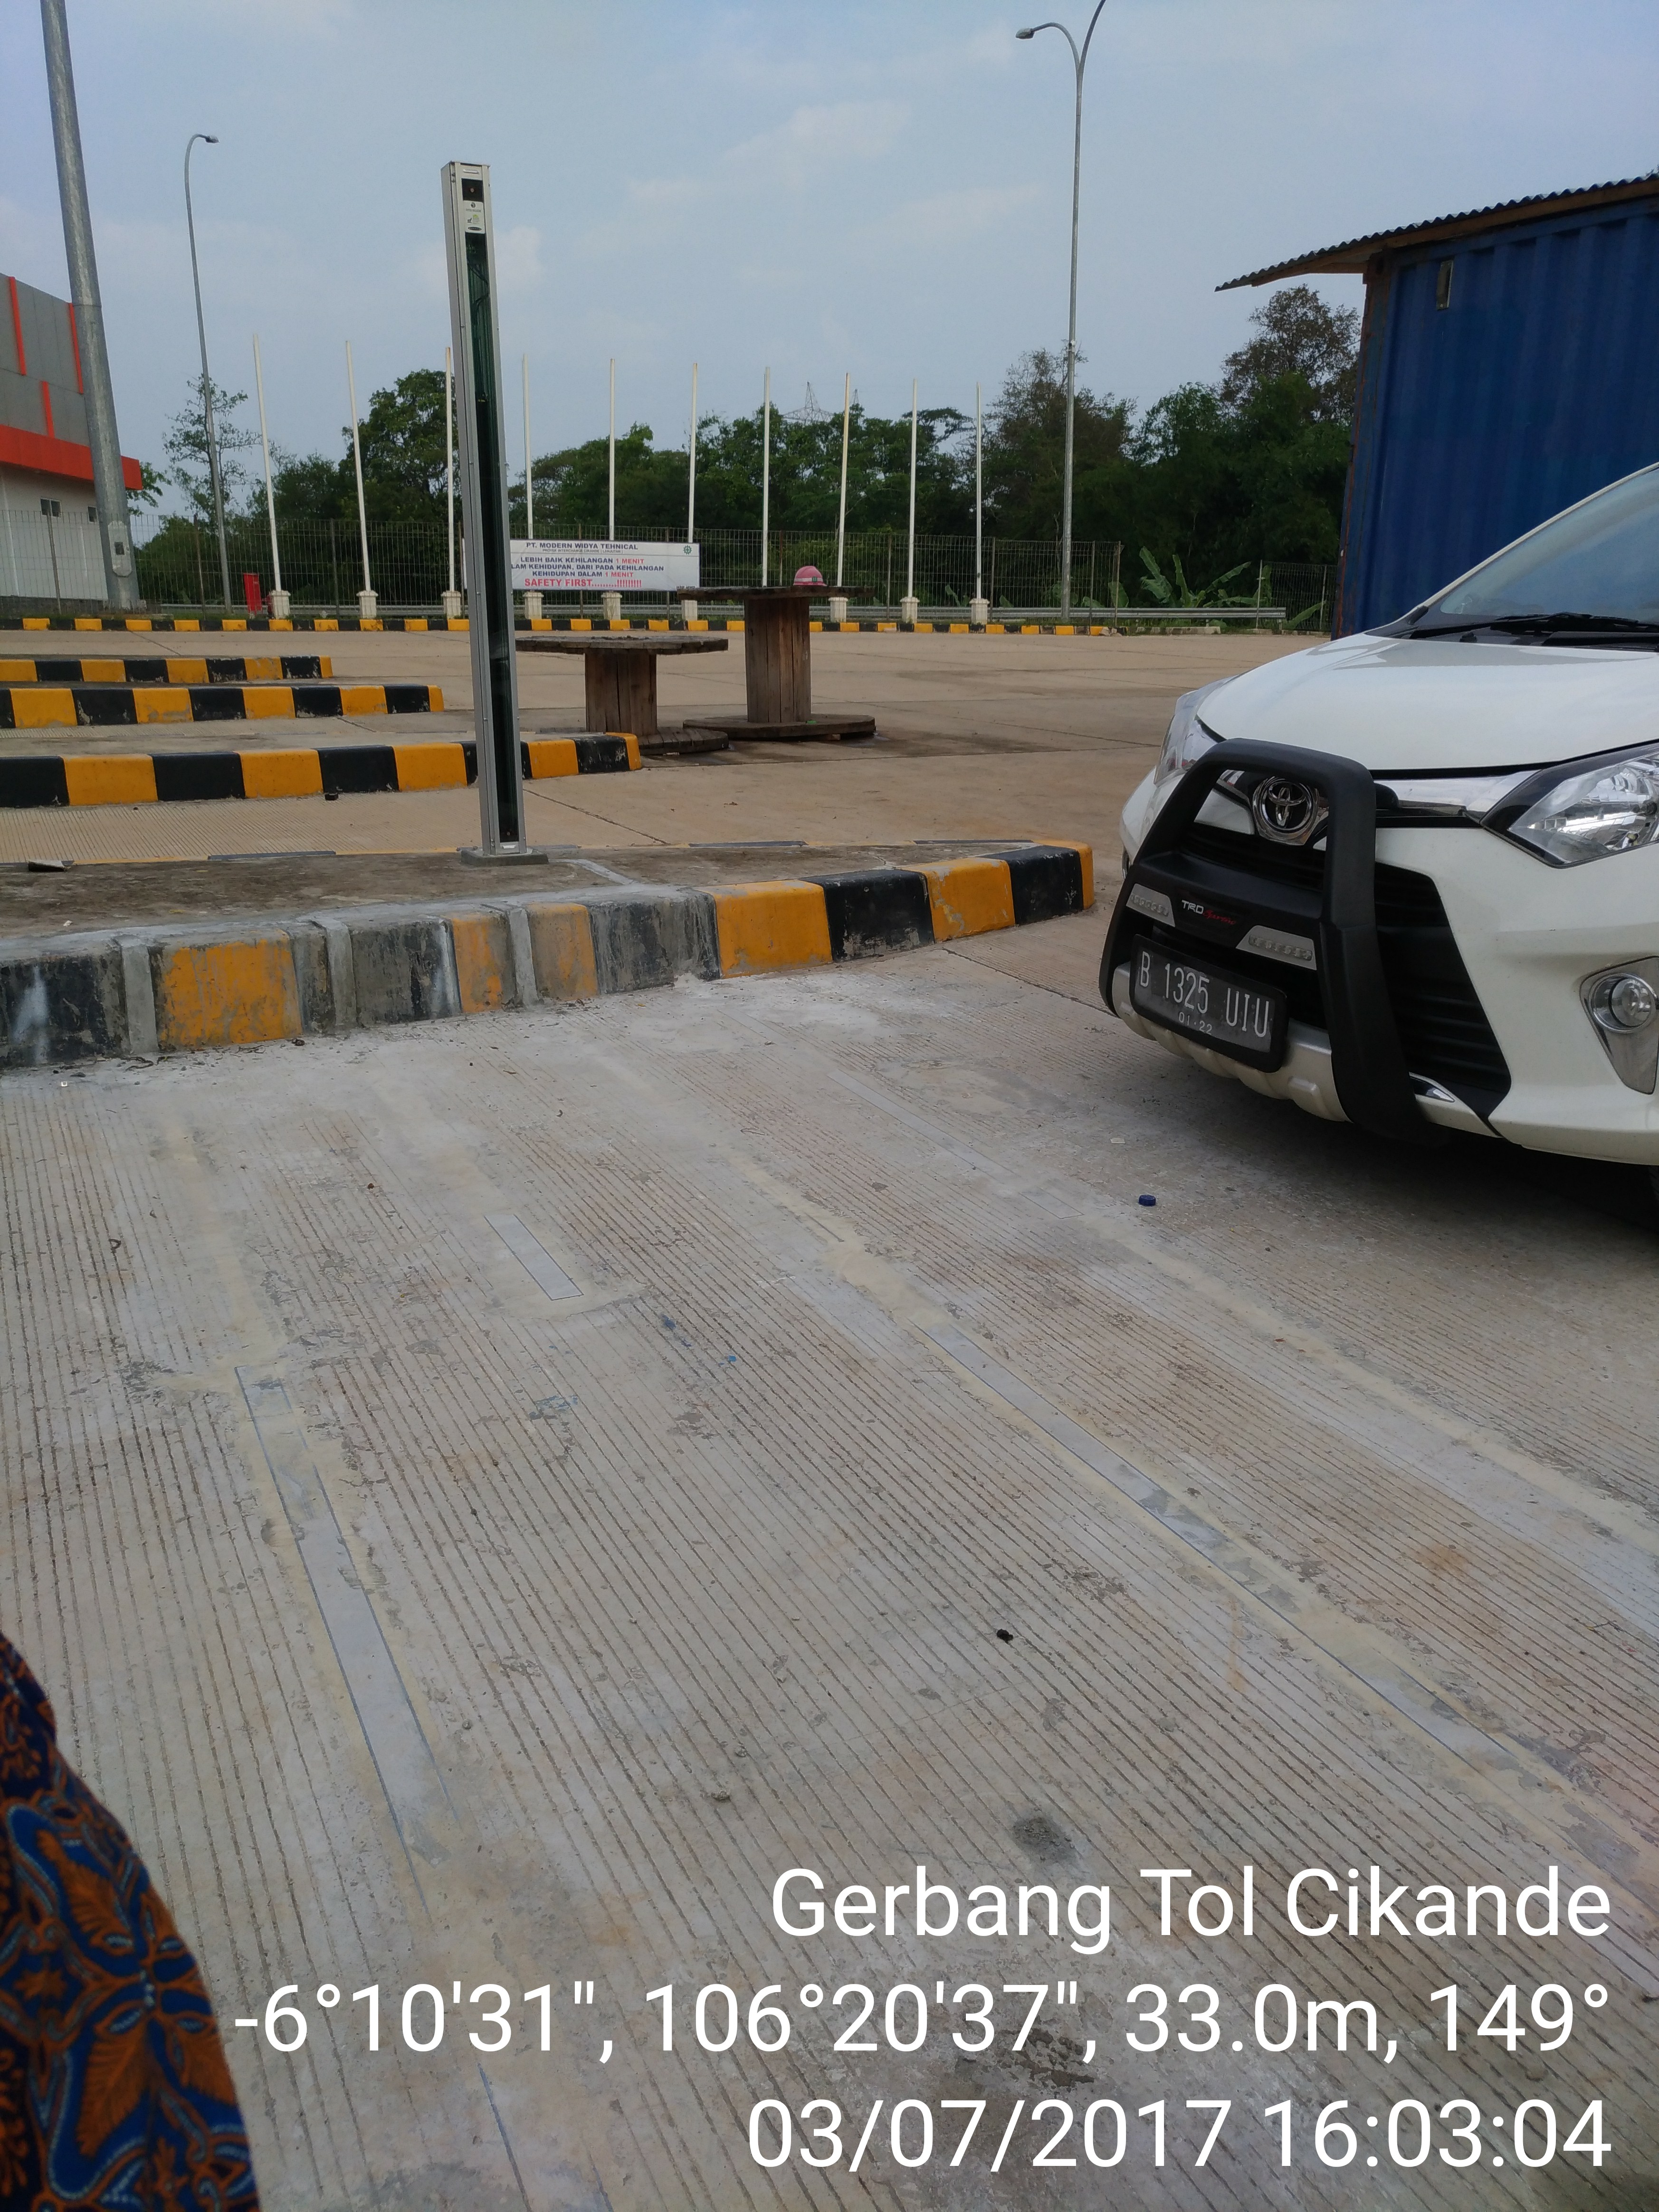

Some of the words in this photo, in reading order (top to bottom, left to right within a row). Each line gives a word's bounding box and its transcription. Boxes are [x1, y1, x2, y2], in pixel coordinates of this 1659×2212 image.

[524, 578, 562, 586] SAFETY
[1182, 899, 1204, 915] TRD
[1140, 951, 1150, 987] B
[1164, 963, 1210, 1013] 1325
[1226, 988, 1269, 1038] UIU
